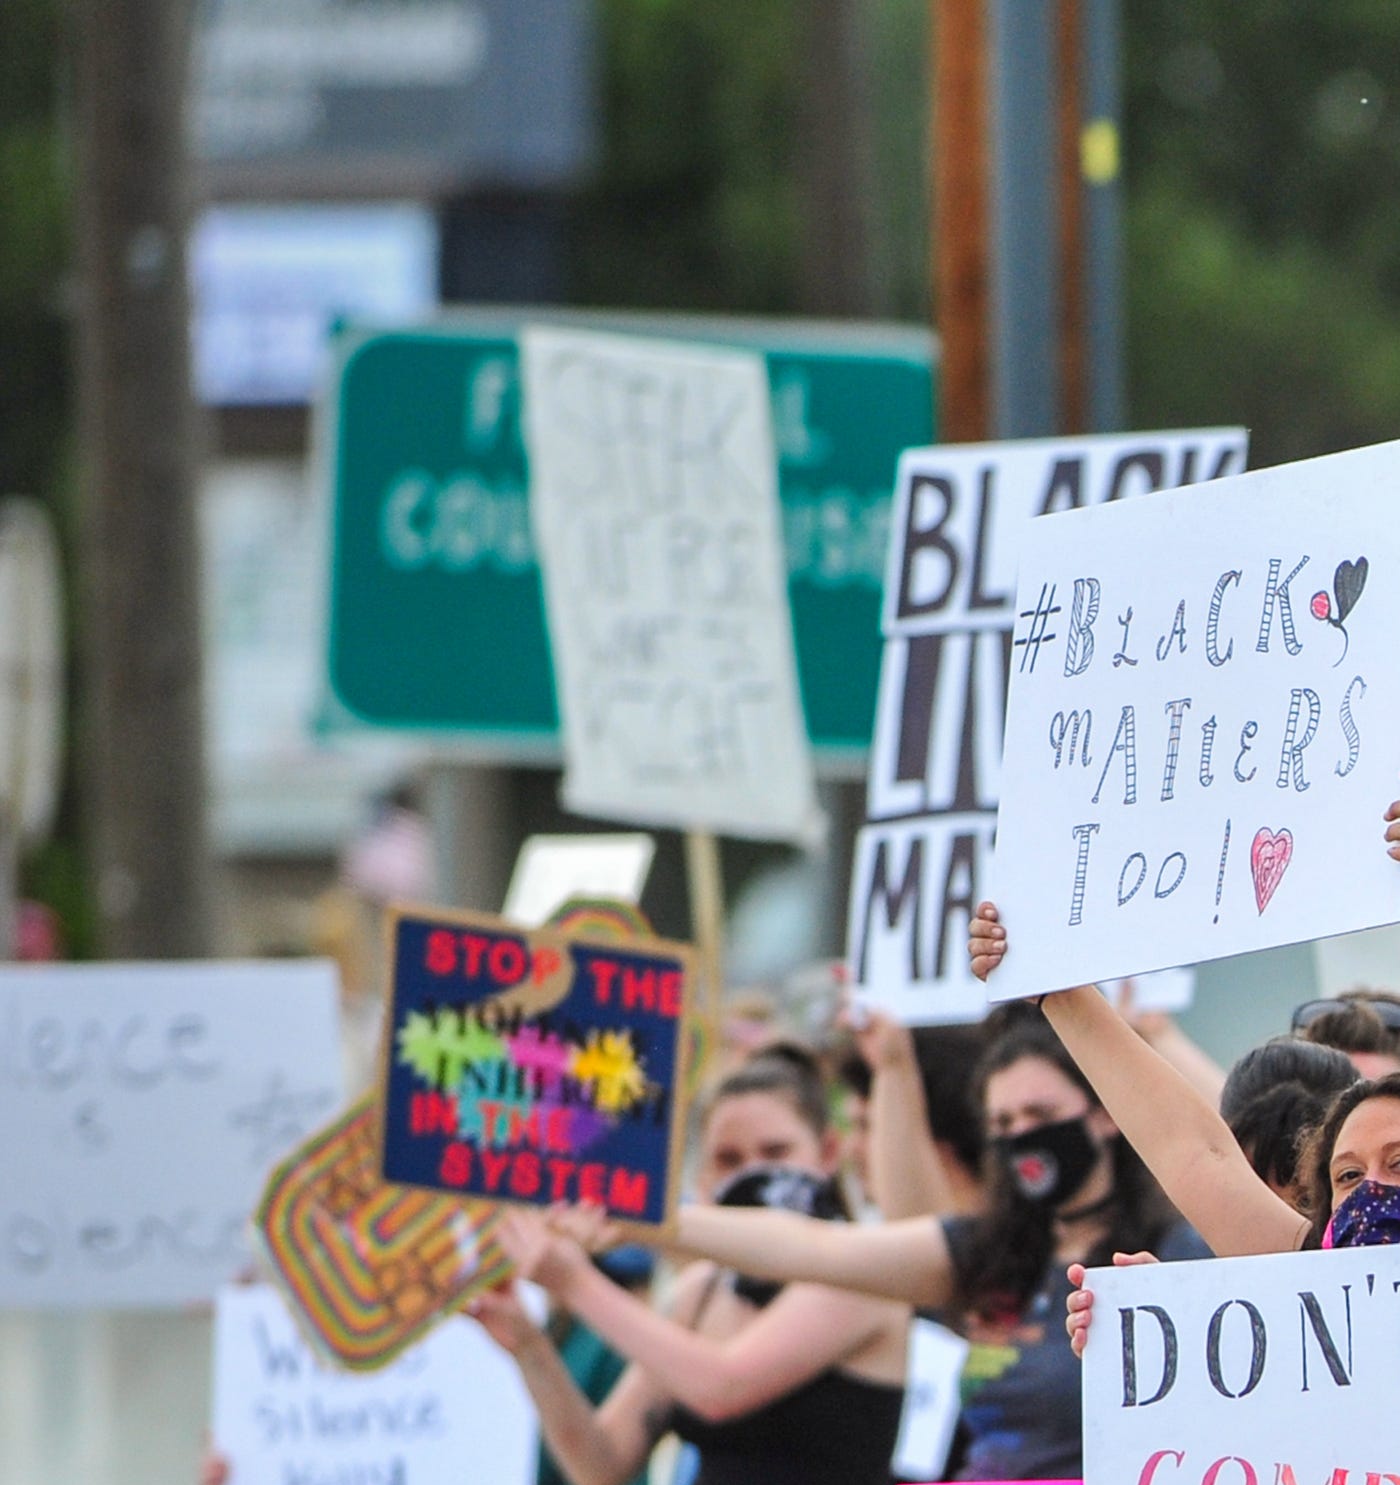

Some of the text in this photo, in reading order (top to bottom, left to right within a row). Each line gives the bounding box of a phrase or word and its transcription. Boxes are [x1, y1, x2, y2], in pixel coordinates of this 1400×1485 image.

[1014, 556, 1309, 677] #BLACK
[426, 930, 683, 1017] STOP THE
[410, 1091, 574, 1152] IN THE
[440, 1142, 648, 1213] SYSTEM
